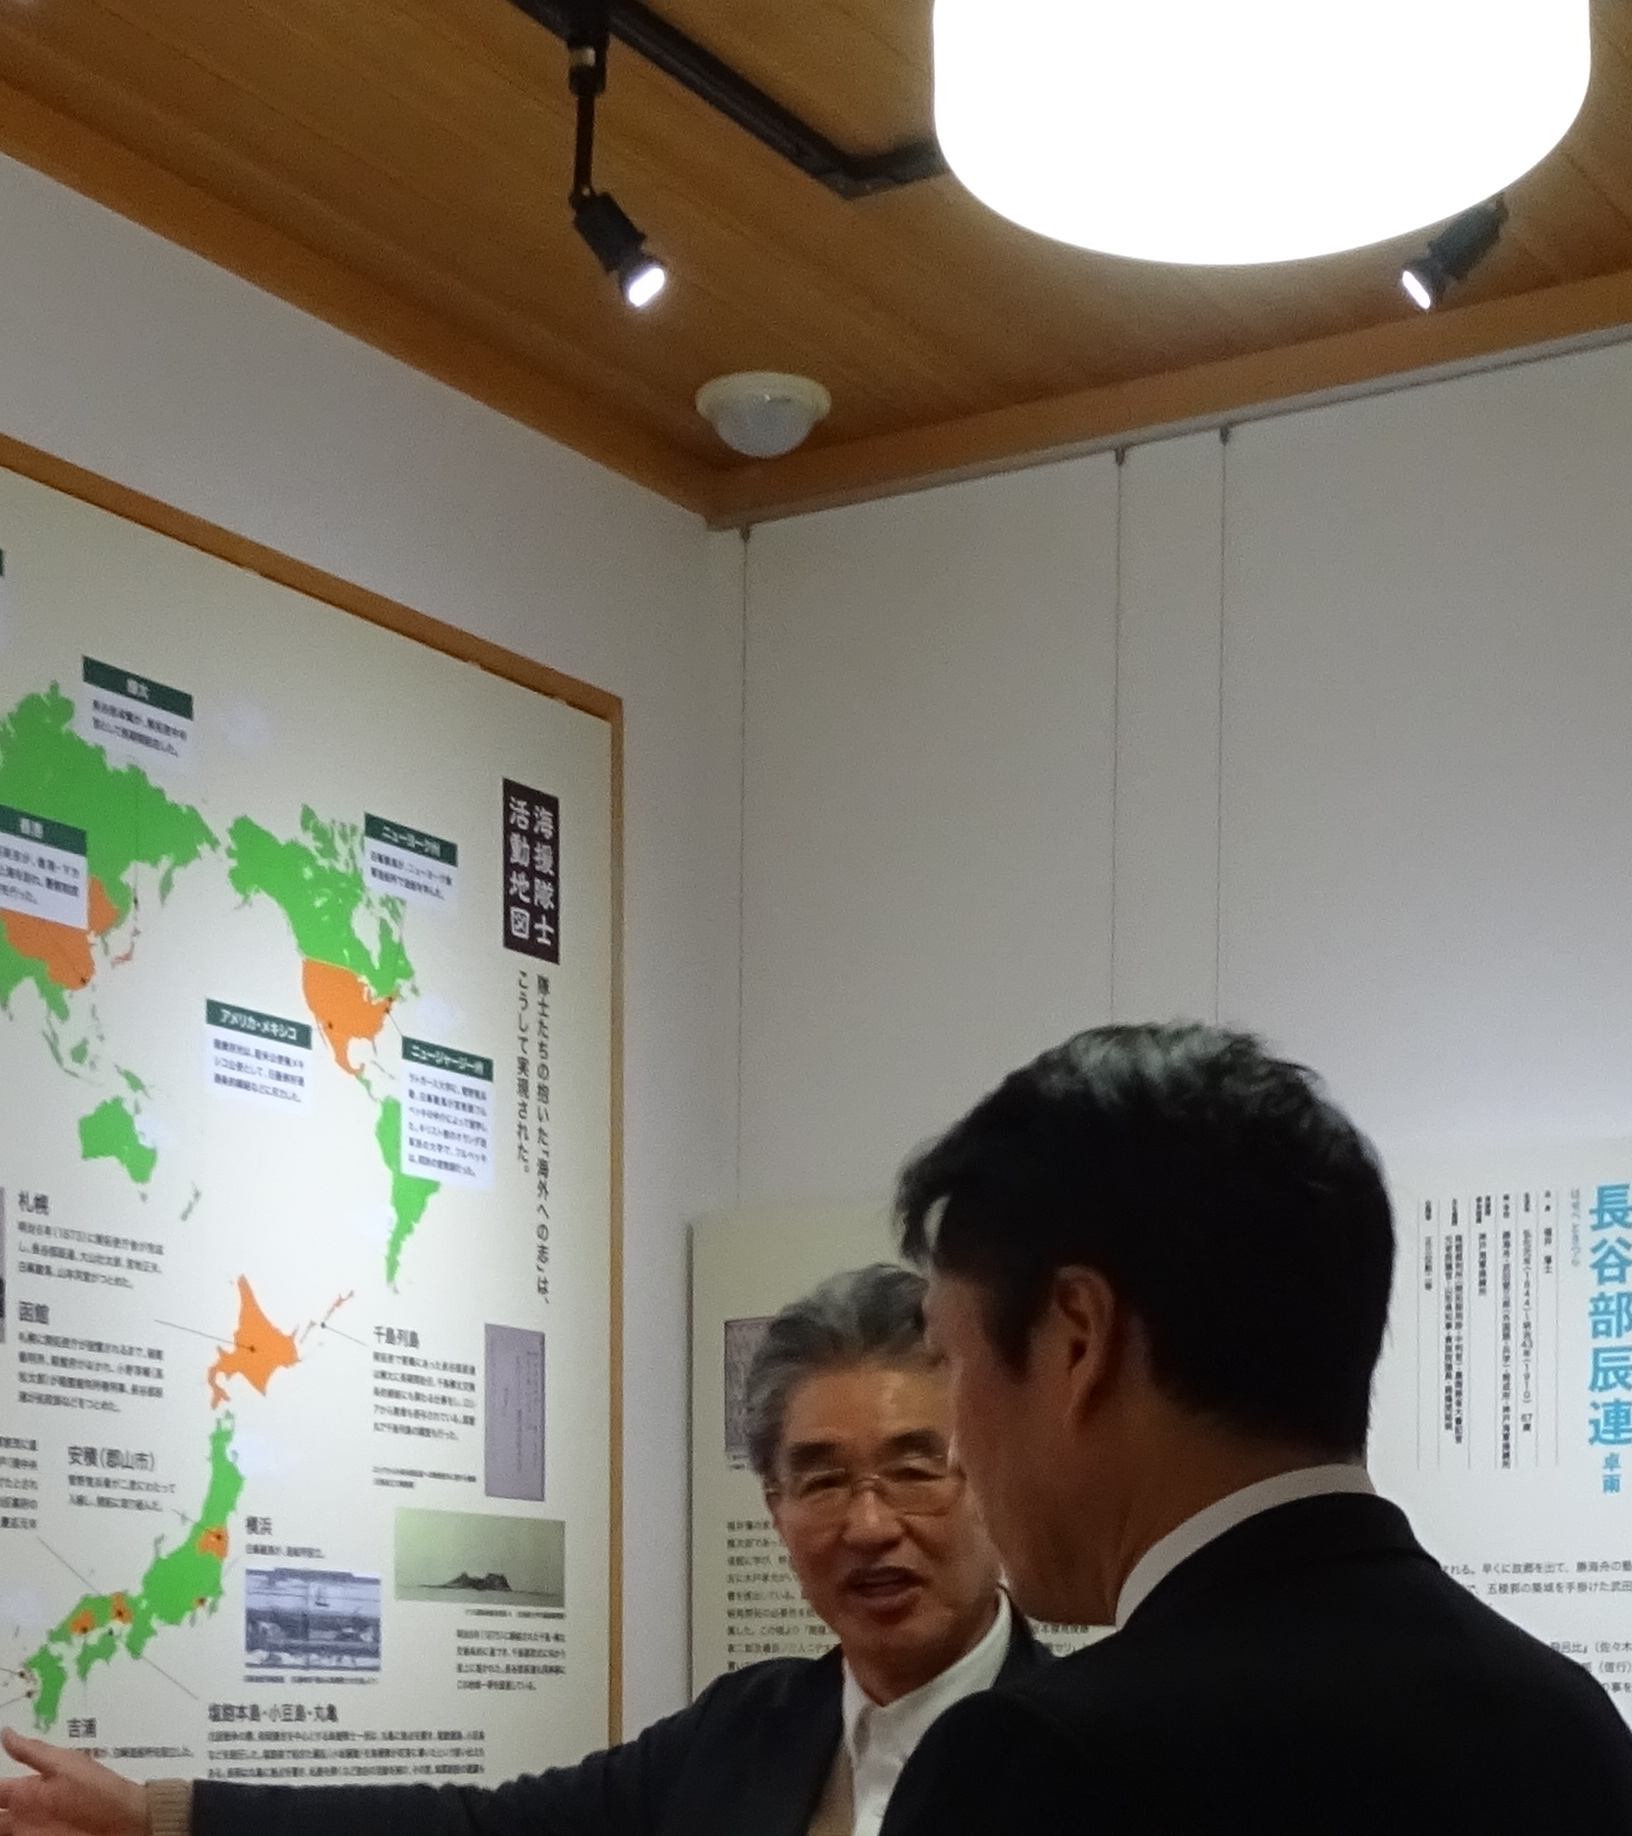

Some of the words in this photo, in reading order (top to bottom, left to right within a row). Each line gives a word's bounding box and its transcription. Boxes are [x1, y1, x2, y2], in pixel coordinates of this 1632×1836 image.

[509, 794, 530, 942] 活動地図
[533, 802, 554, 947] 海援隊士
[17, 1189, 49, 1216] 札幌
[18, 1300, 50, 1325] 函館
[372, 1324, 419, 1349] 千島列島
[245, 1515, 272, 1536] 横浜
